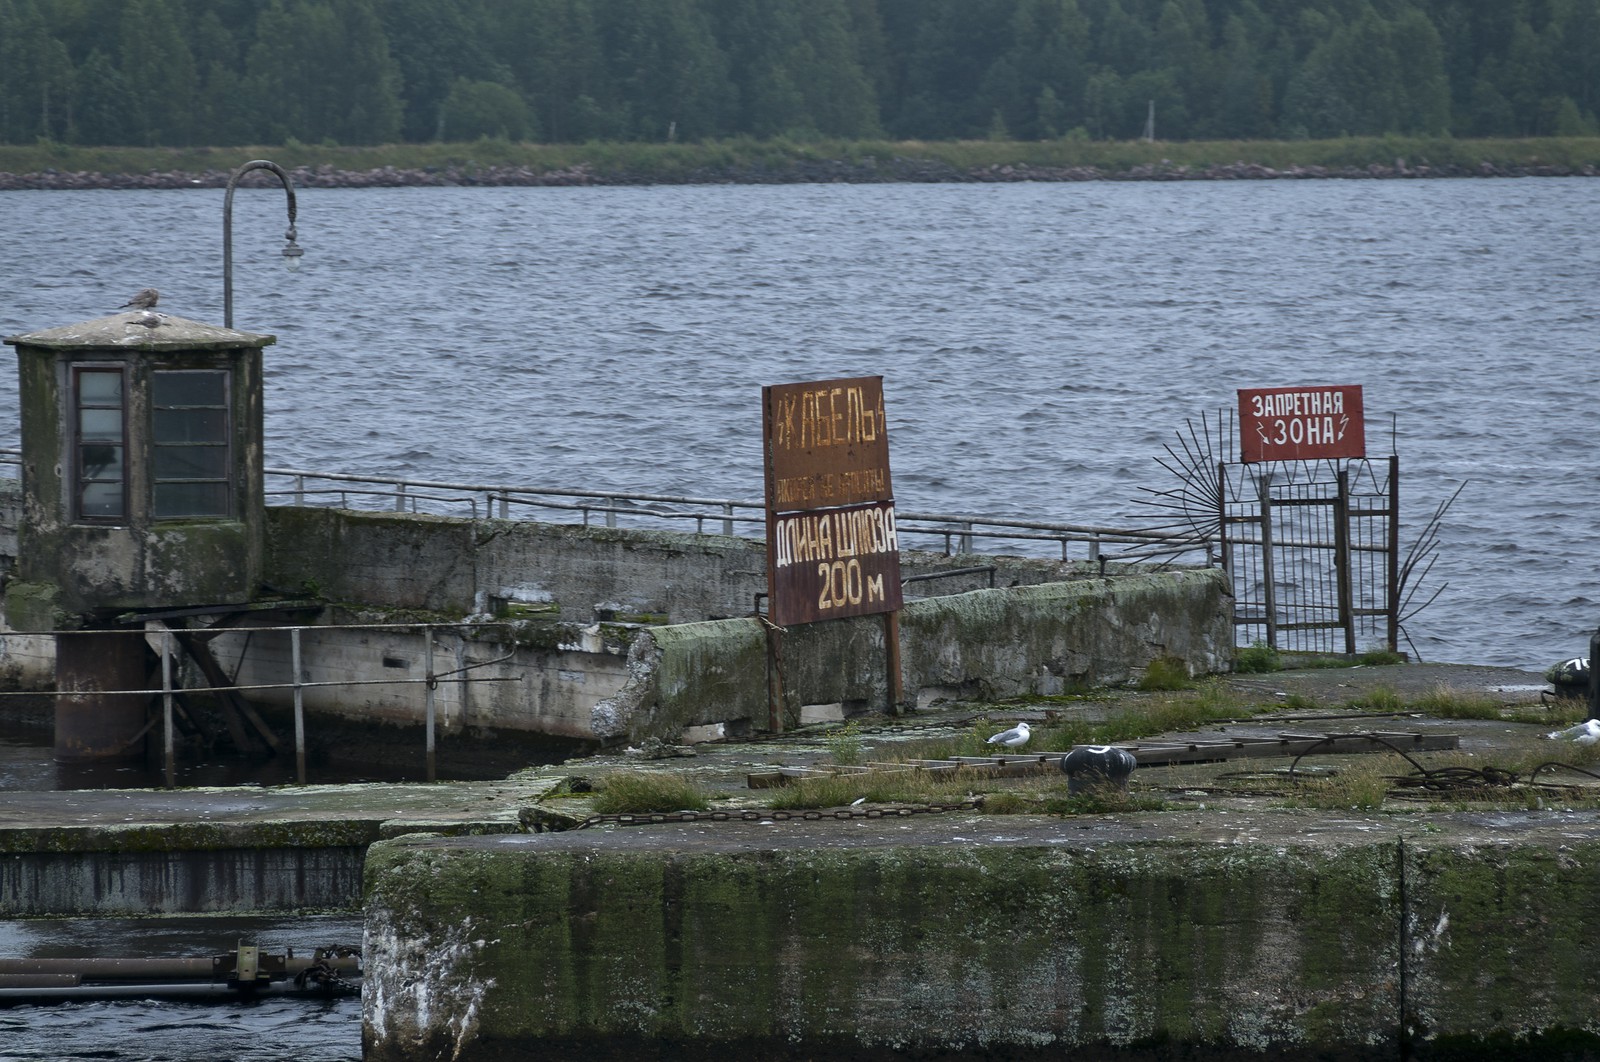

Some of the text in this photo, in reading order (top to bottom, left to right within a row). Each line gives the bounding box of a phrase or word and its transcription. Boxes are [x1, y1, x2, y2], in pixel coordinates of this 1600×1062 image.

[784, 386, 876, 450] КАБЕЛЬ
[1251, 391, 1344, 418] ЗАПРЕТНАЯ
[1273, 416, 1335, 446] ЗОНА
[776, 506, 898, 568] ДЛИНА ШЛЮЗА
[818, 558, 863, 610] 200
